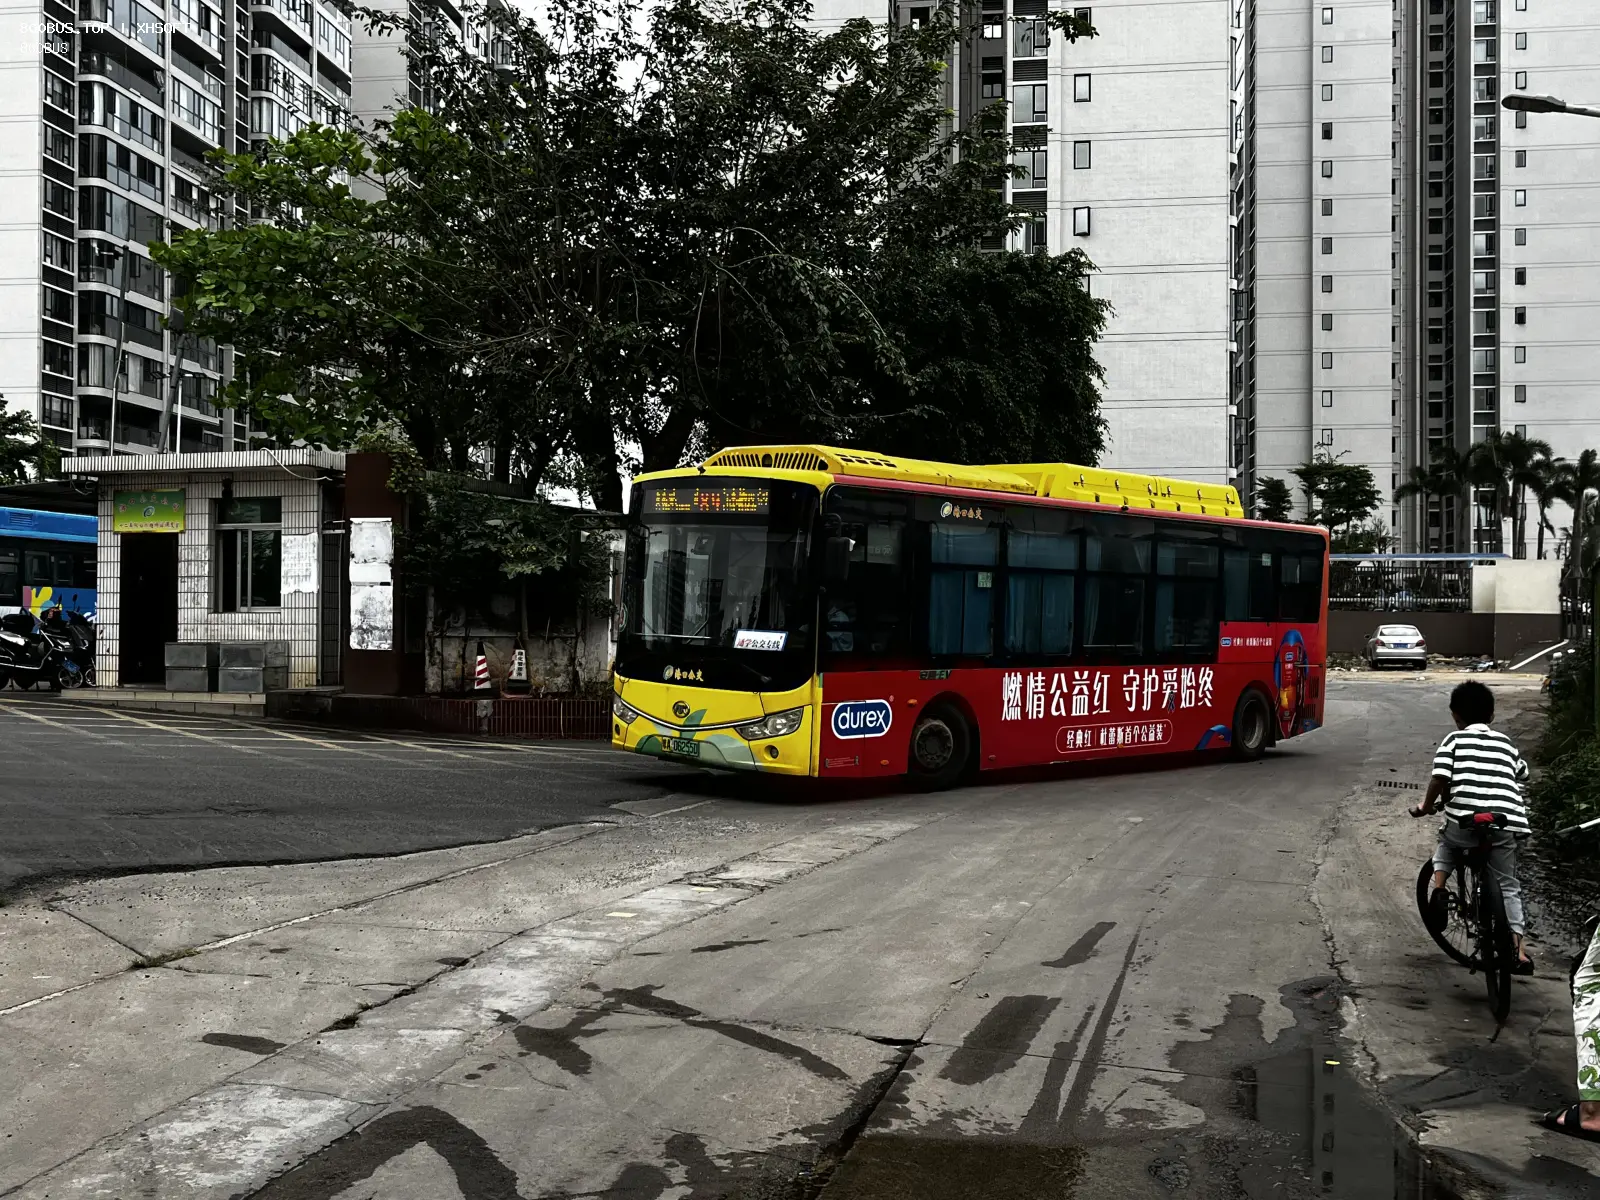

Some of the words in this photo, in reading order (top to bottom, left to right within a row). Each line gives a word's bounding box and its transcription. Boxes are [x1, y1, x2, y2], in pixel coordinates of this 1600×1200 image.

[1001, 671, 1111, 721] 燃情公益红
[1122, 667, 1214, 714] 守护爱始终
[837, 706, 887, 731] durex
[1066, 728, 1092, 749] 经典红
[1099, 723, 1164, 746] 杜蕾斯首个公益装
